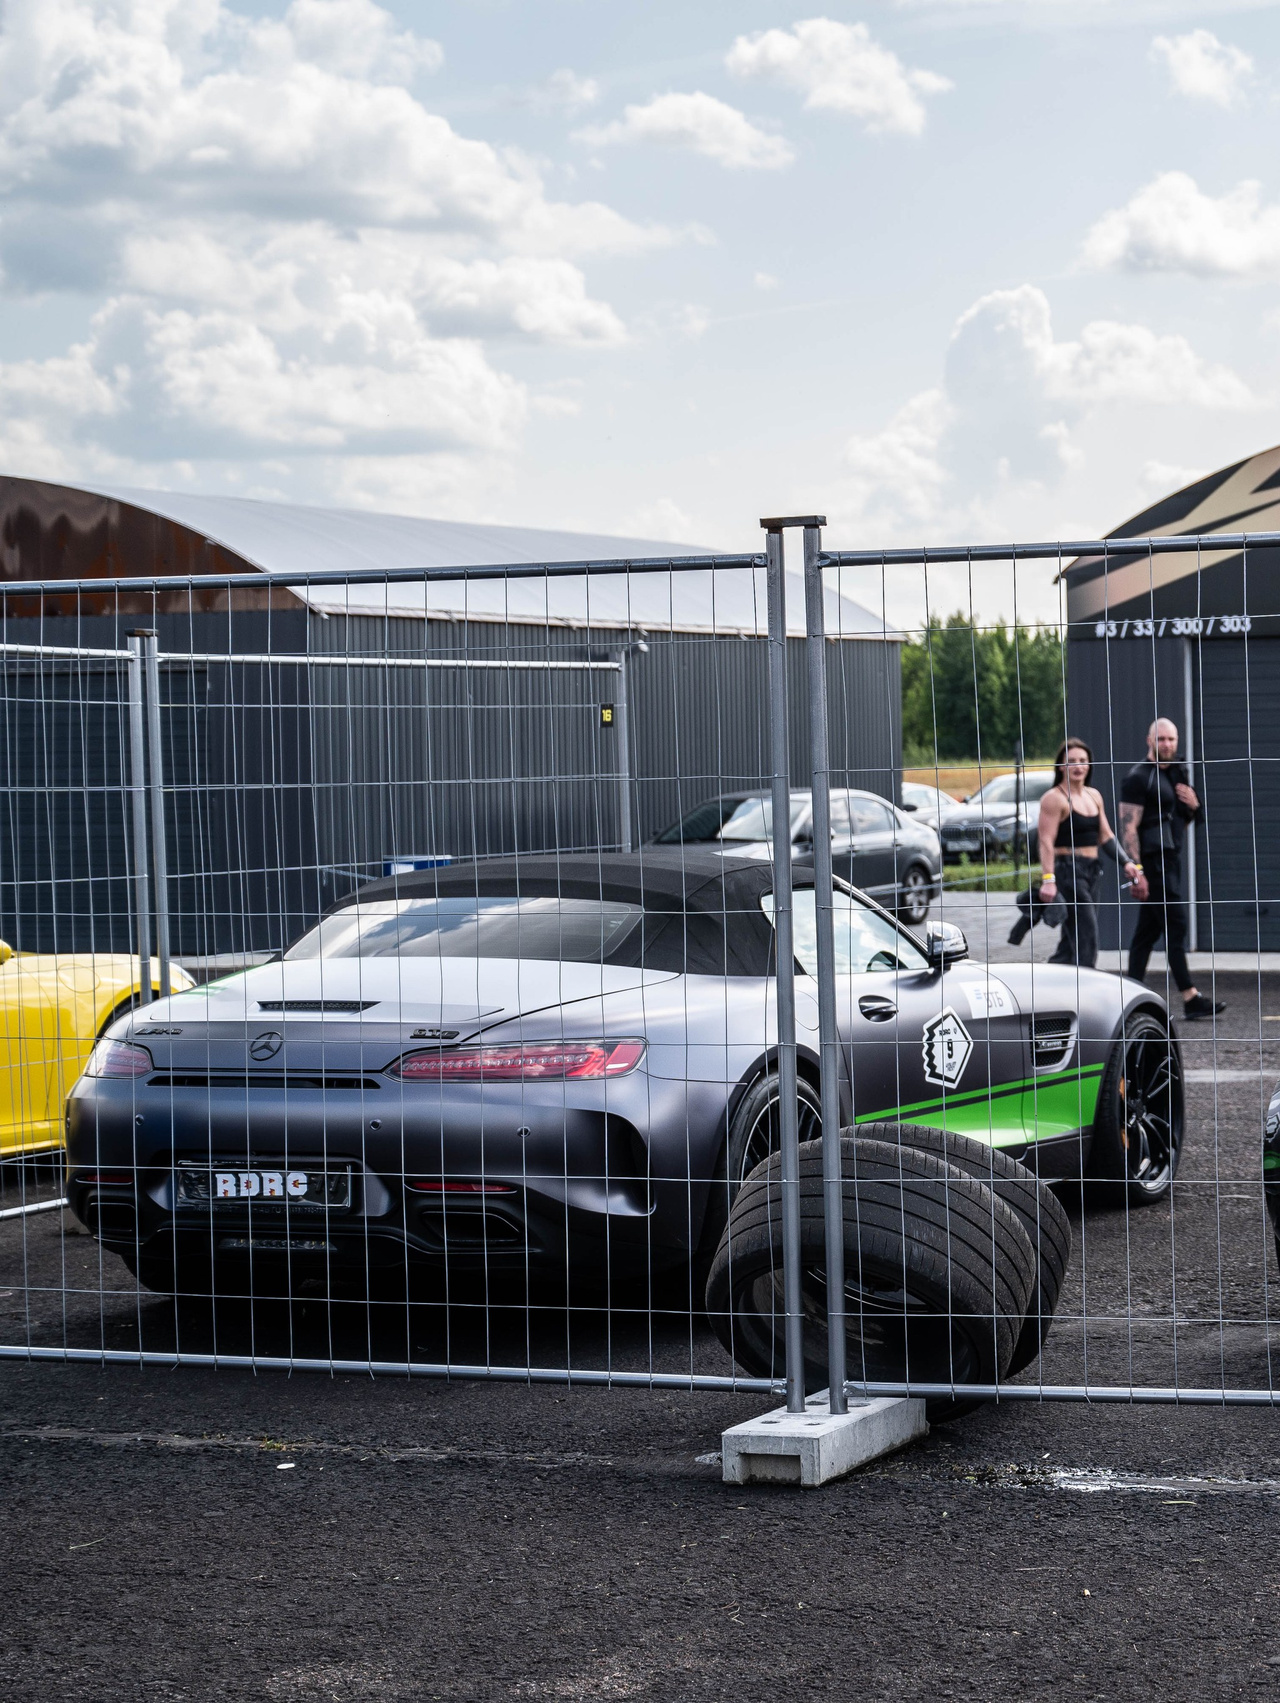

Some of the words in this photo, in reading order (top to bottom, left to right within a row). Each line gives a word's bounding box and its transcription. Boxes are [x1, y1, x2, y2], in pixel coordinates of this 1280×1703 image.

[1133, 617, 1154, 636] 33
[1171, 616, 1203, 635] 300
[1220, 614, 1252, 633] 303
[602, 709, 612, 721] 16
[947, 1038, 954, 1059] 9
